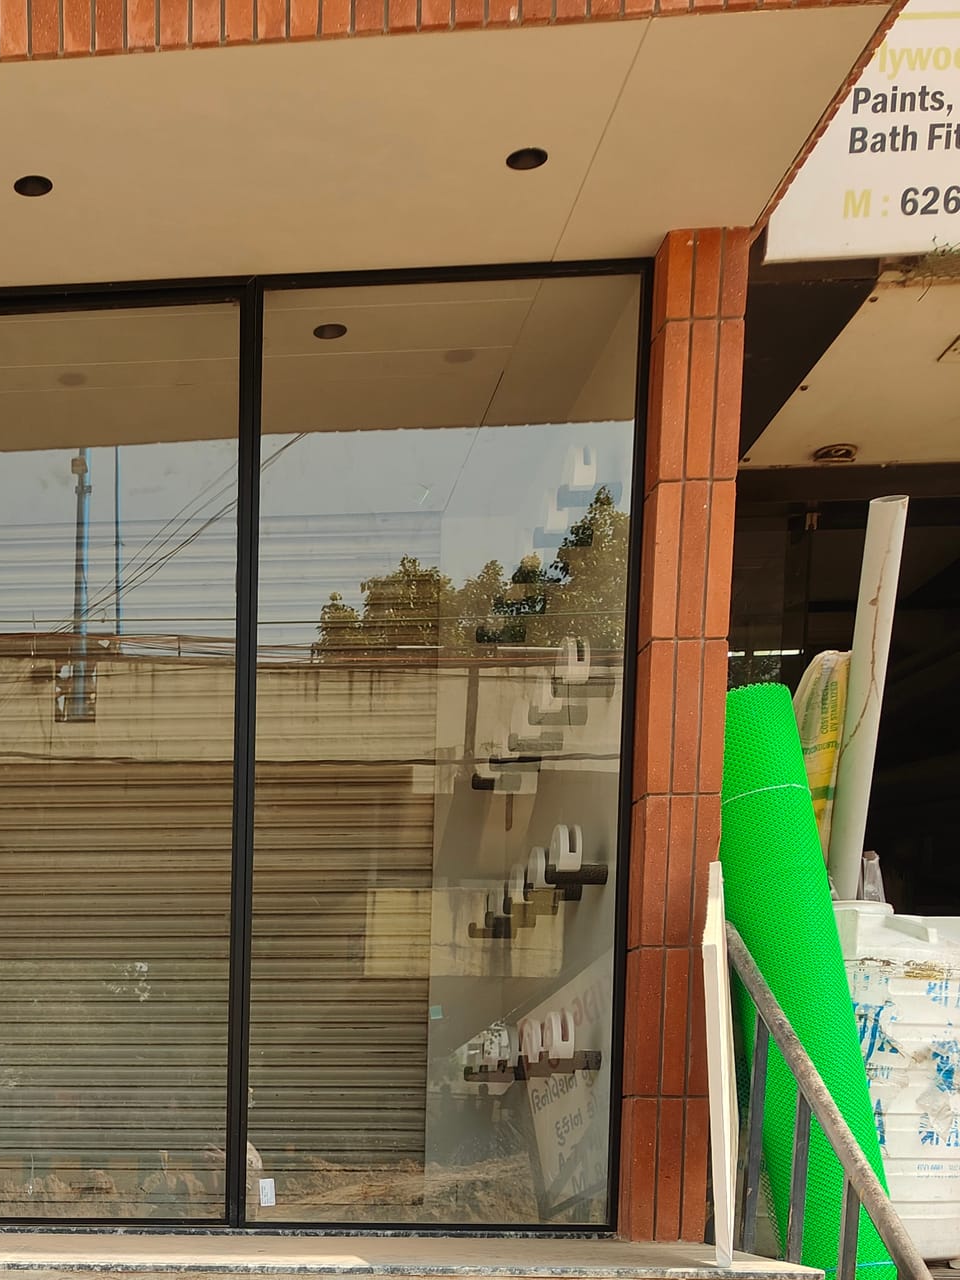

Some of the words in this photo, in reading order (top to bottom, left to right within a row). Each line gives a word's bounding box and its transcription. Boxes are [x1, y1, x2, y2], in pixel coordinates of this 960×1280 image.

[876, 40, 960, 80] lywo
[852, 86, 953, 116] Paints,
[848, 124, 918, 154] Bath
[900, 185, 960, 216] 626
